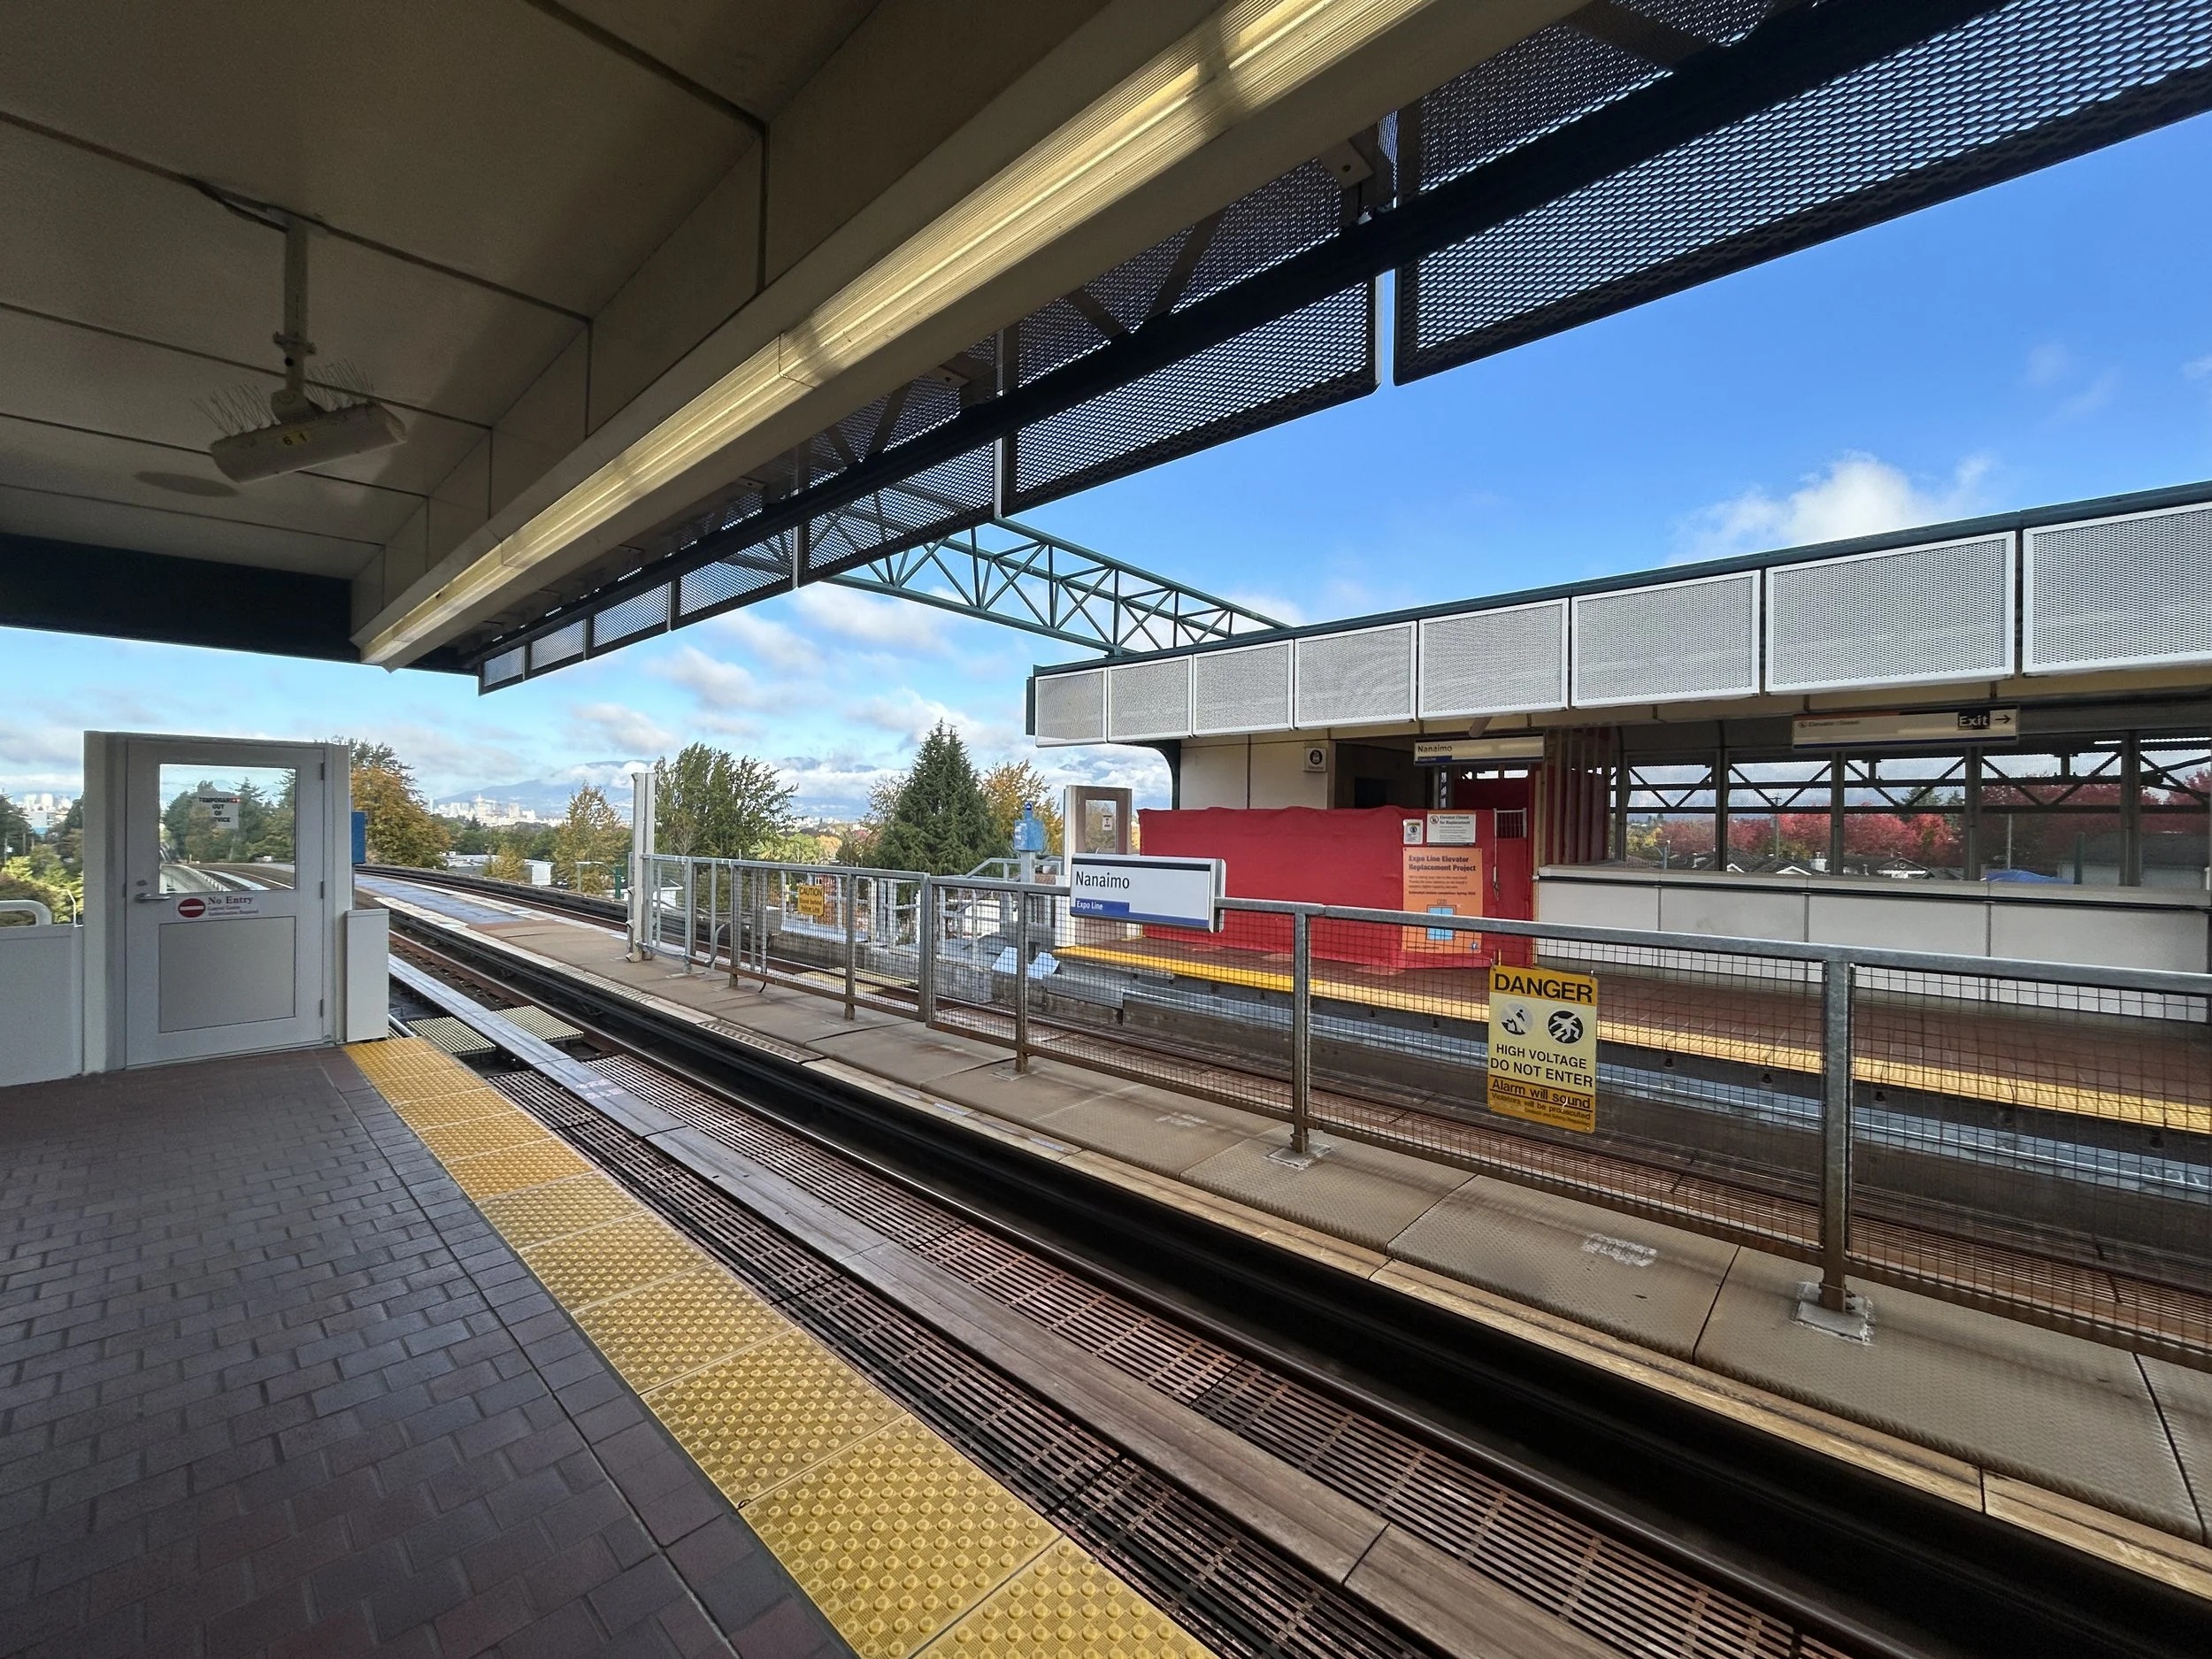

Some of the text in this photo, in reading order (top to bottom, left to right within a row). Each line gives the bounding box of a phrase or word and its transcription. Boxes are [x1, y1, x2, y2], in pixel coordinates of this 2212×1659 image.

[1959, 715, 1989, 726] Exit
[1417, 744, 1453, 753] Nanaimo
[1409, 855, 1425, 864] Expo
[1075, 871, 1130, 889] Nanaimo
[799, 887, 823, 897] CAUTION
[226, 895, 254, 904] Entry
[1076, 900, 1103, 910] Expo Line
[1494, 973, 1593, 1002] DANGER
[1496, 1043, 1586, 1069] HIGH VOLTAGE
[1490, 1057, 1593, 1087] DO NOT ENTER
[1492, 1079, 1591, 1110] Alarm will sound
[1492, 1092, 1521, 1105] Violators
